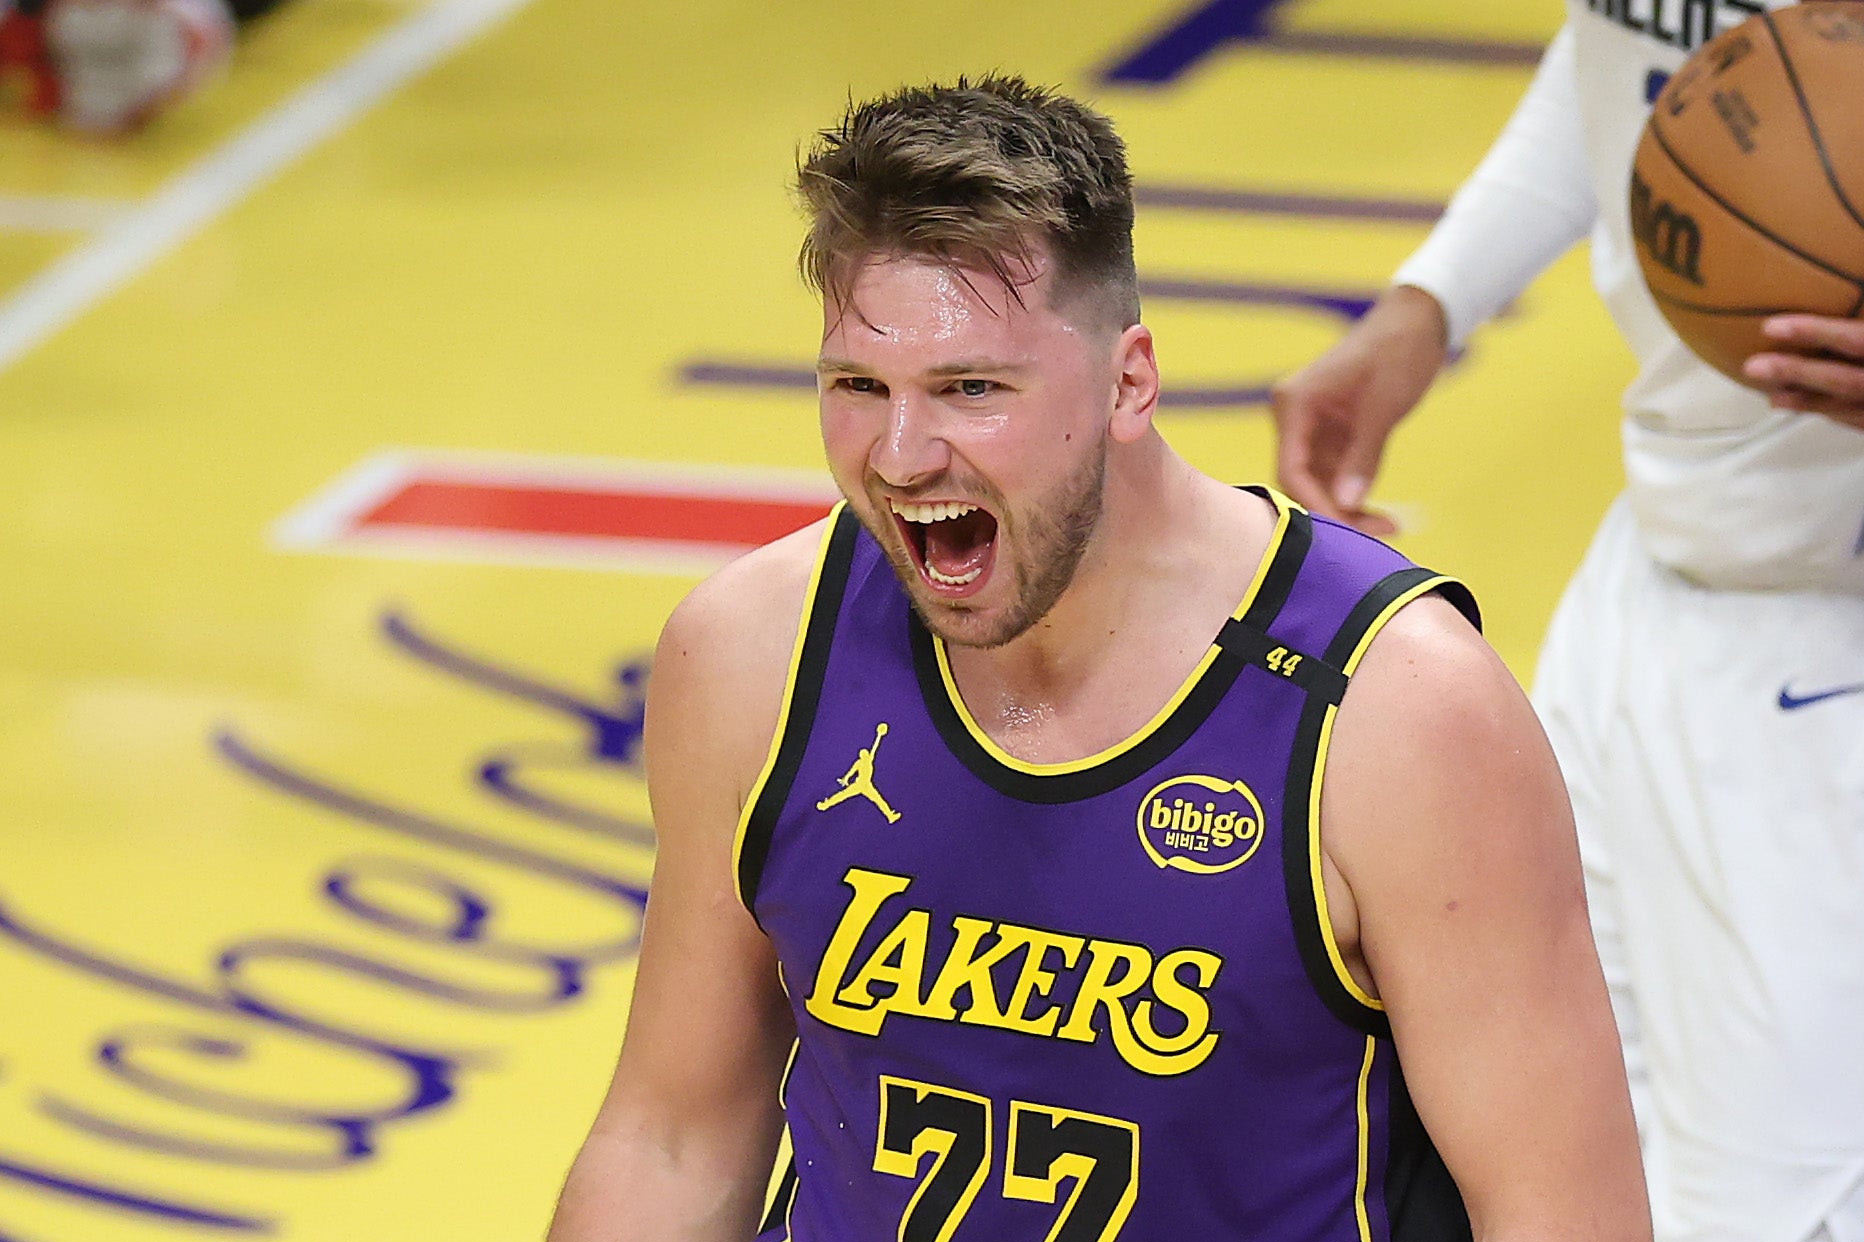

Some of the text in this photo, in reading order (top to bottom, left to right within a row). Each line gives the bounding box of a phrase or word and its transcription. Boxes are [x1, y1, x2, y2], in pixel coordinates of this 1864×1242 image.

[1264, 645, 1304, 678] 44
[1149, 797, 1257, 849] bibigo
[1164, 831, 1209, 852] 비비고
[804, 866, 1224, 1077] LAKERS
